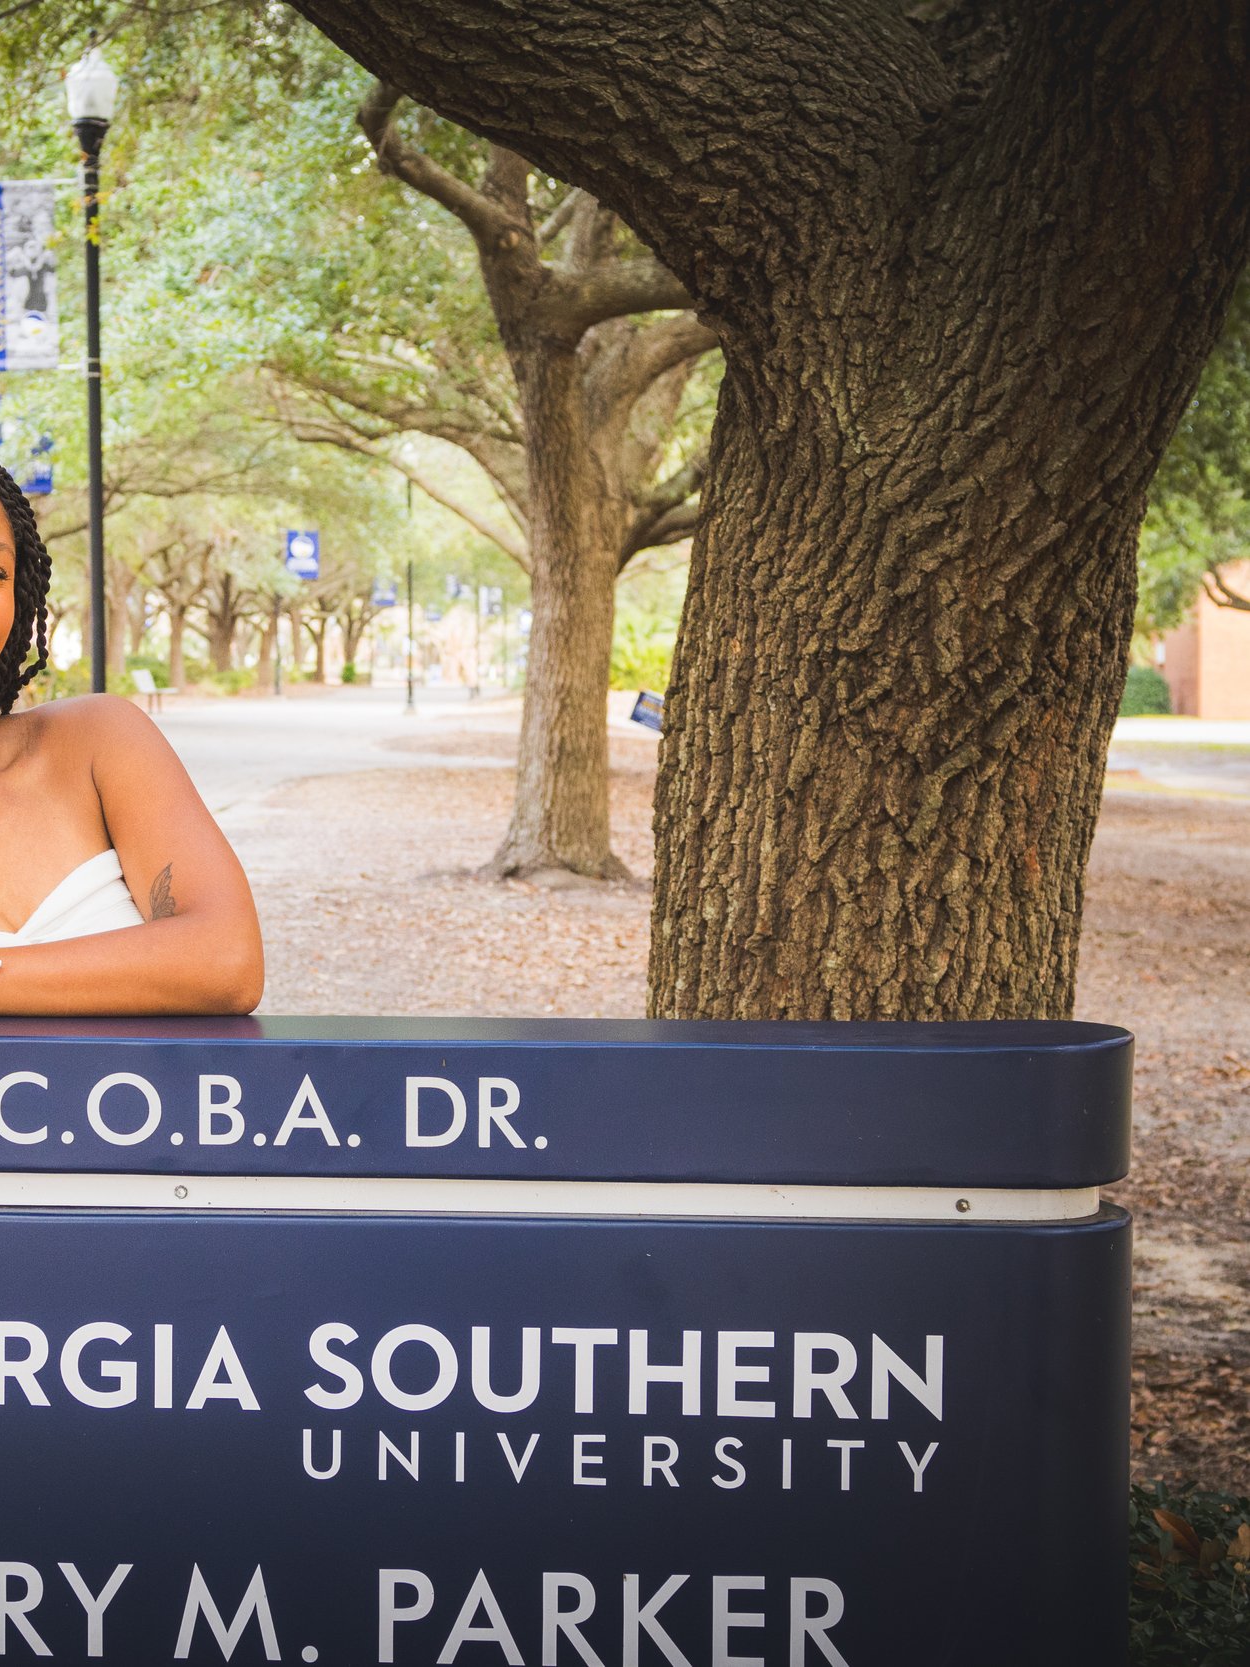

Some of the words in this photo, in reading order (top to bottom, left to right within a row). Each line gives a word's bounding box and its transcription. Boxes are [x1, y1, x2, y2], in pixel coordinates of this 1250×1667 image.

[405, 1076, 548, 1150] DR.
[303, 1322, 944, 1422] SOUTHERN
[302, 1428, 940, 1493] UNIVERSITY
[174, 1563, 319, 1663] M.
[378, 1568, 850, 1667] PARKER
